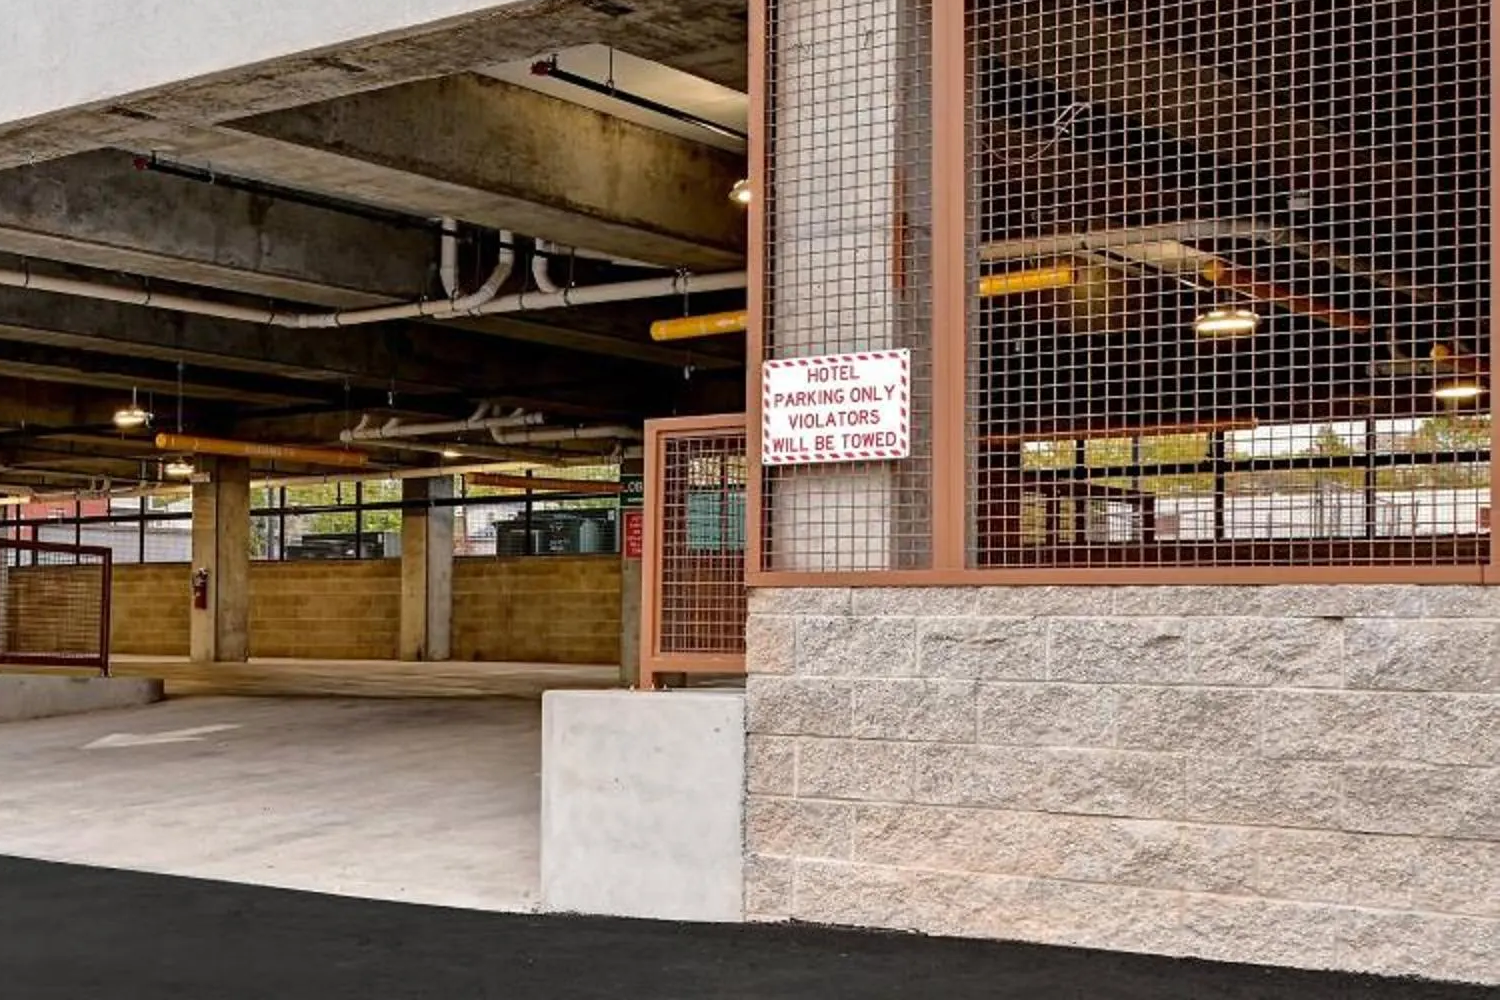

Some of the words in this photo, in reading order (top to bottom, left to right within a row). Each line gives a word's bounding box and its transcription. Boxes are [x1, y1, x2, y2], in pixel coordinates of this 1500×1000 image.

[807, 365, 860, 383] HOTEL
[773, 388, 845, 408] PARKING
[850, 384, 896, 403] ONLY
[788, 409, 881, 430] VIOLATORS
[772, 436, 808, 453] WILL
[815, 435, 835, 451] BE
[841, 431, 897, 449] TOWED
